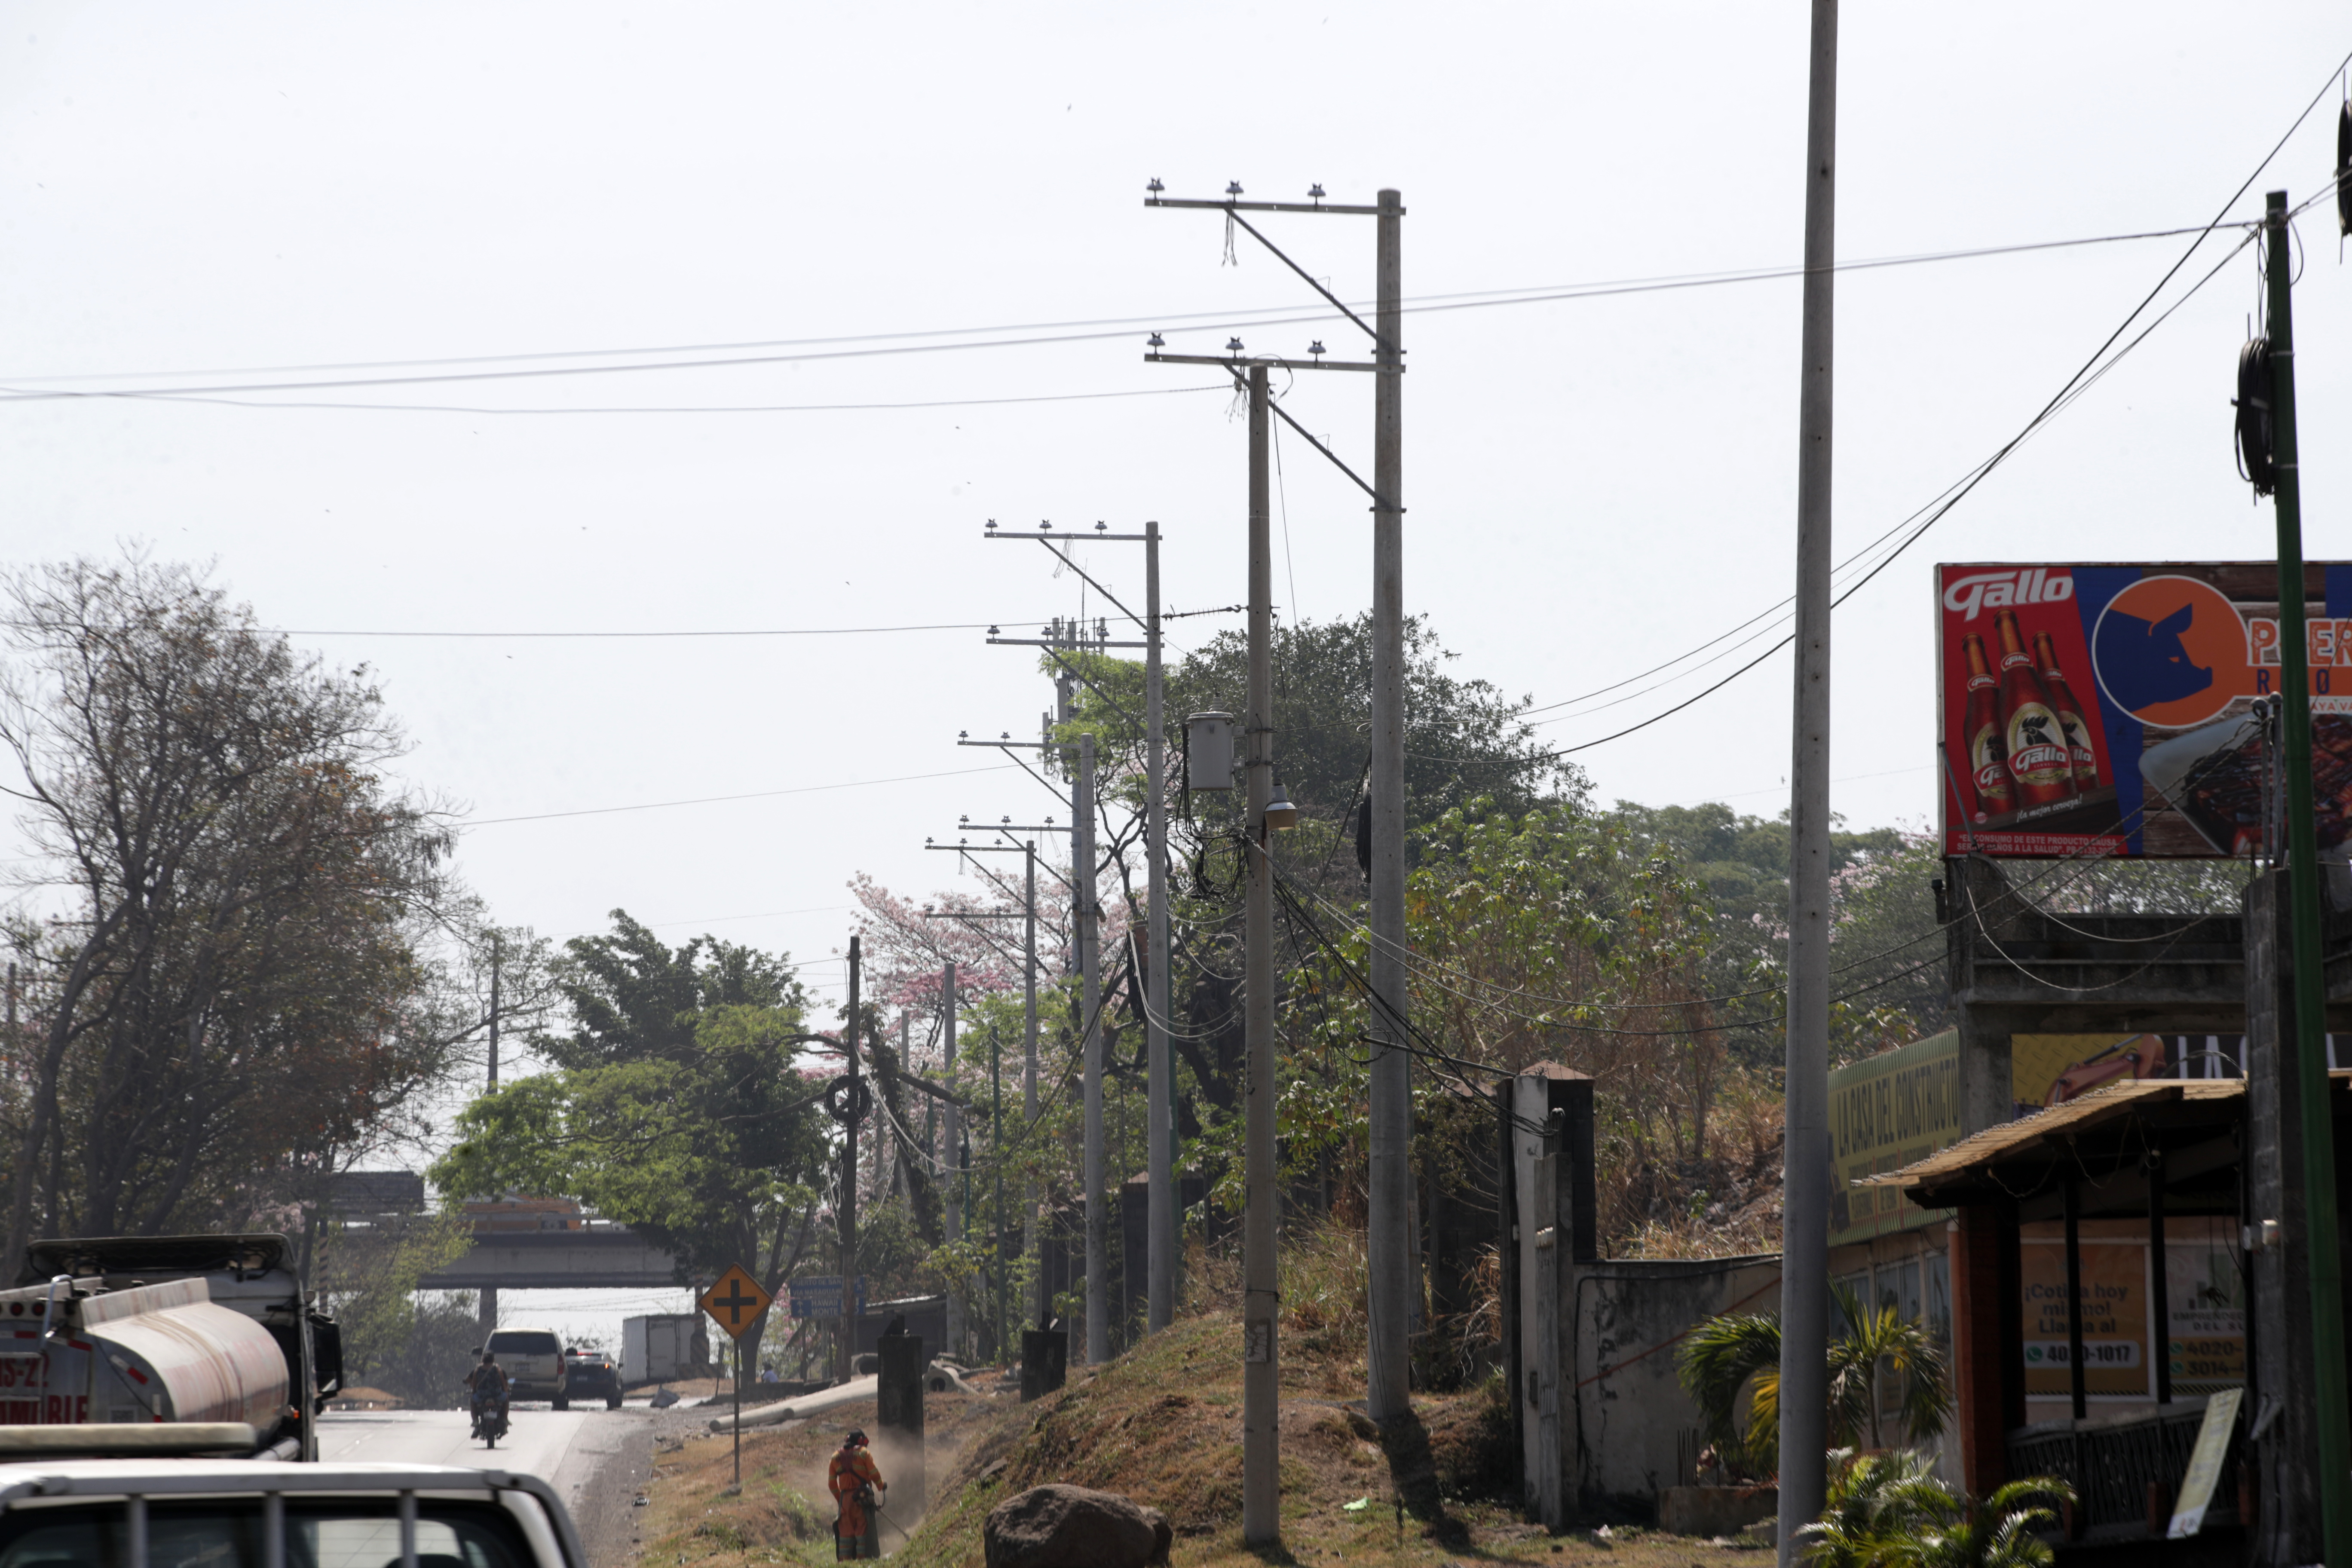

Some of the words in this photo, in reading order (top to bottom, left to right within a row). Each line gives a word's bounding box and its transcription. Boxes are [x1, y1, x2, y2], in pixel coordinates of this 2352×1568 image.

[1943, 568, 2073, 622] Gallo
[2250, 620, 2352, 665] PER
[2004, 655, 2030, 666] Gallo
[1971, 677, 1995, 686] Gallo
[2015, 746, 2066, 771] Gallo
[2029, 805, 2052, 818] mejor
[1974, 834, 2012, 843] CONSUMO
[2026, 836, 2046, 844] ESTE
[2047, 836, 2089, 845] PRODUCTO
[1838, 1091, 1850, 1158] LA
[1850, 1083, 1874, 1154] CASA
[1876, 1076, 1895, 1146] DEL
[1896, 1057, 1959, 1142] CONSTRUCTO
[2095, 1283, 2129, 1302] hoy
[2039, 1318, 2094, 1333] Llaa
[2100, 1318, 2116, 1333] al
[2047, 1345, 2130, 1362] 400-1017
